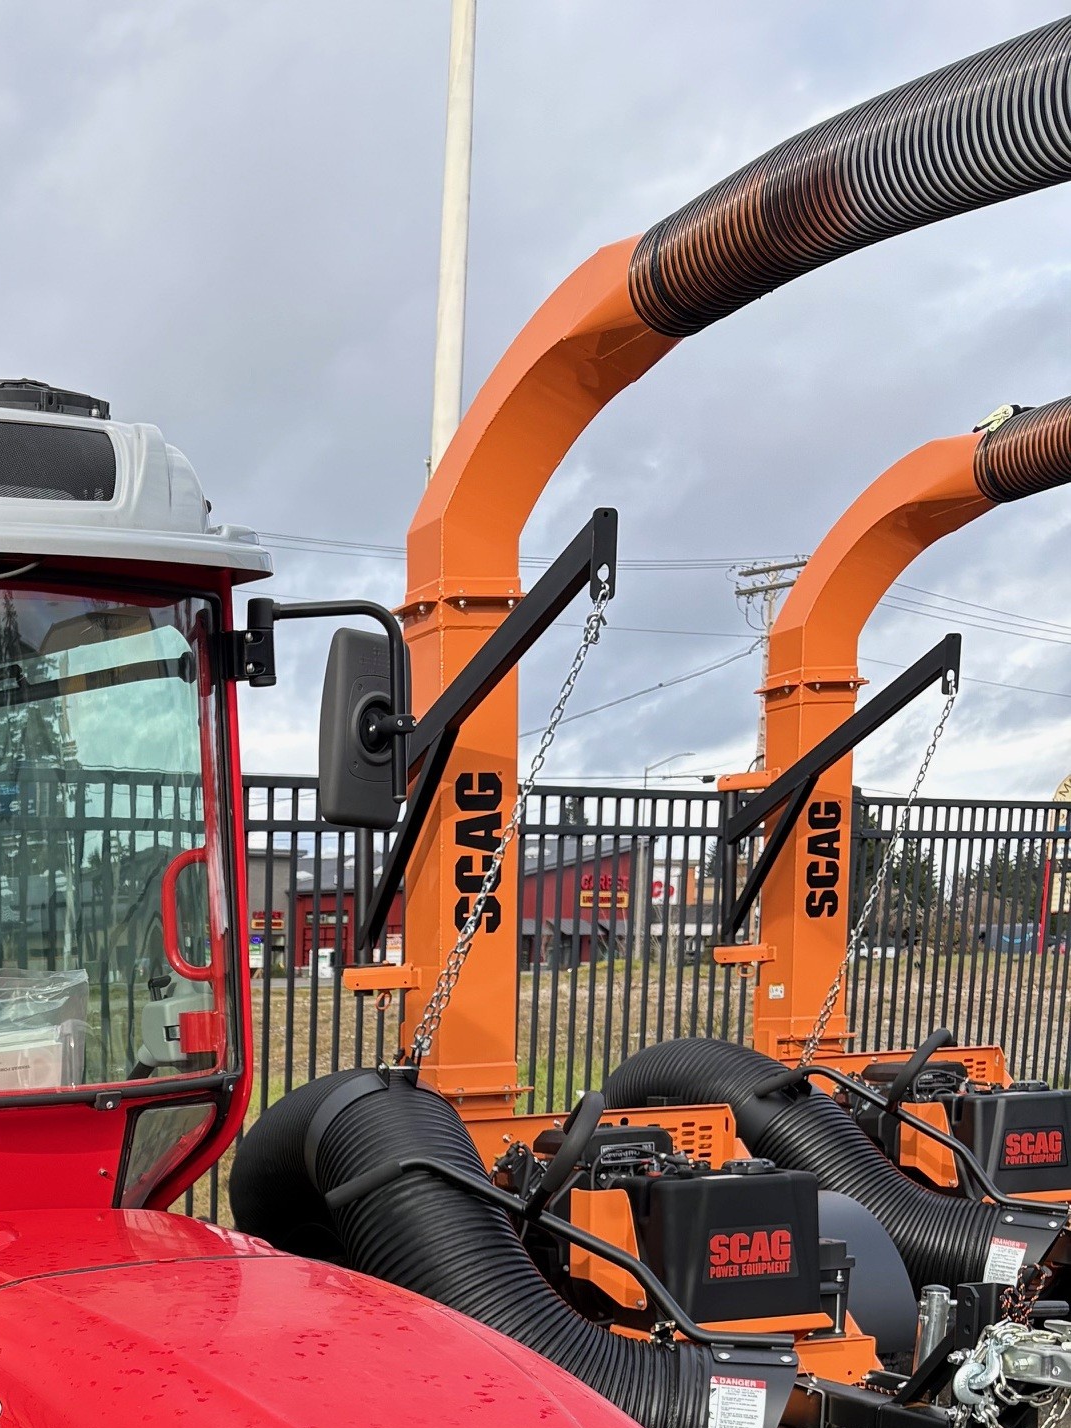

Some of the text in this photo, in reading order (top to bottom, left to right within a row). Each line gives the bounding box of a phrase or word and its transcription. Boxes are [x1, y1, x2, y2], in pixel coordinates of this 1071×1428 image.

[455, 772, 503, 934] SCAG
[805, 801, 842, 918] SCAG
[1005, 1130, 1063, 1157] SCAG
[1005, 1152, 1061, 1166] POWER EQUIPMENT
[709, 1229, 792, 1266] SCAG
[709, 1260, 791, 1279] POWER EQUIPMENT
[719, 1376, 757, 1388] DANGER
